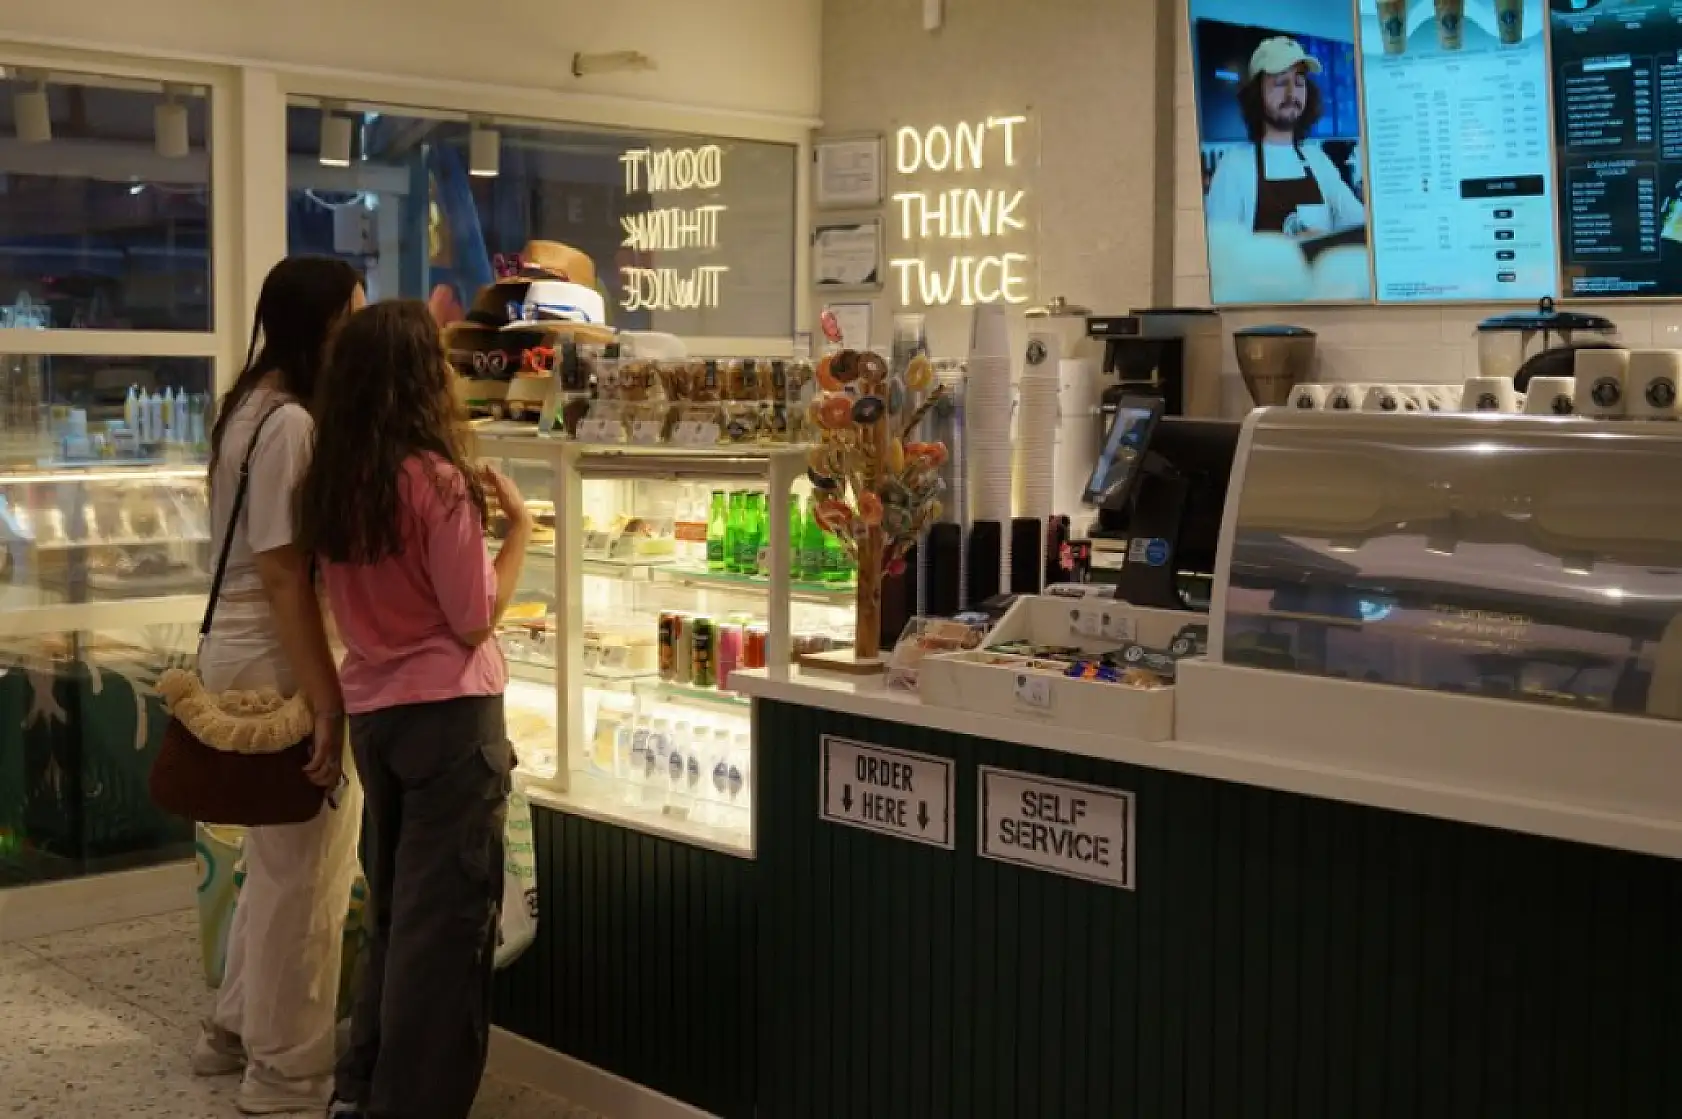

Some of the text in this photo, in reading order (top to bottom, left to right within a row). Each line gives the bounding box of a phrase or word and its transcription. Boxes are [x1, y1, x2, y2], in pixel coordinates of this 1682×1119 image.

[896, 115, 1027, 174] DON'T
[892, 188, 1025, 239] THINK
[890, 252, 1029, 306] TWICE
[856, 754, 914, 792] ORDER
[862, 793, 908, 828] HERE
[1020, 790, 1089, 826] SELF
[999, 819, 1111, 867] SERVICE
